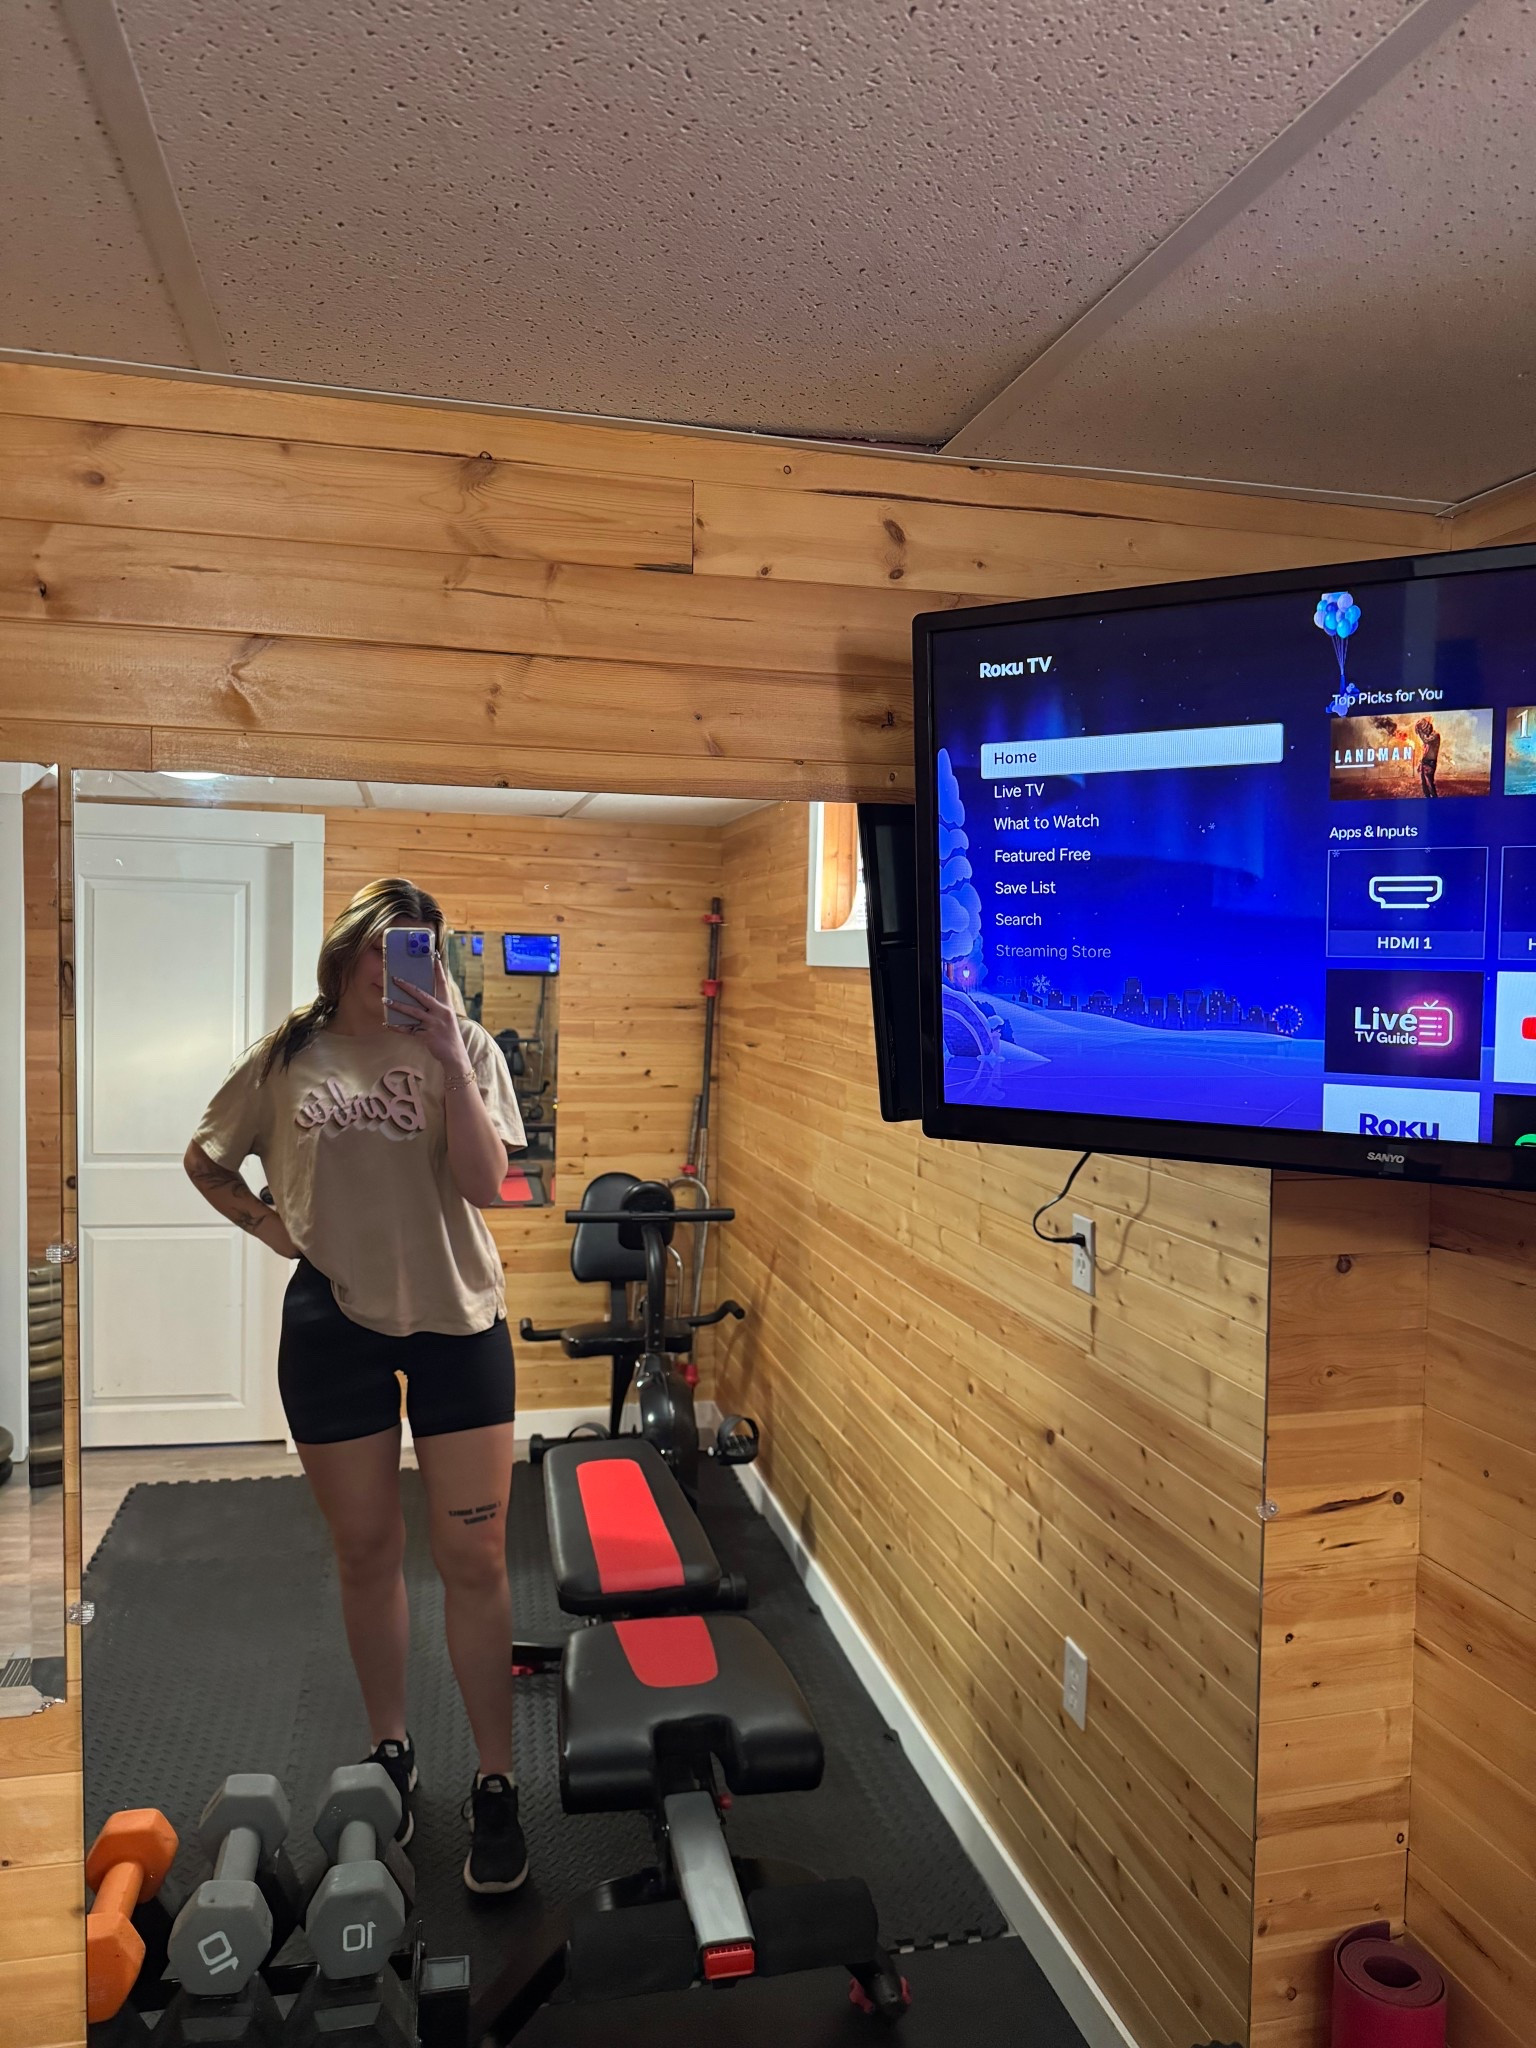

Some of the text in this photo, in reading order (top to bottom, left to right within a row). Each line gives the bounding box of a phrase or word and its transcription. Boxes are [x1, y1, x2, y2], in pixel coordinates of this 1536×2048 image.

[1027, 655, 1053, 674] TV
[1332, 688, 1444, 707] Top Picks for You
[993, 752, 1037, 765] Home
[1334, 747, 1412, 764] LANDMAN
[994, 783, 1045, 799] Live TV
[993, 813, 1100, 831] What to Watch
[1329, 824, 1419, 840] Apps & Inputs
[994, 847, 1092, 863] Featured Free
[995, 880, 1057, 895] Save List
[995, 912, 1043, 926] Search
[1377, 936, 1433, 950] HDMI 1
[995, 944, 1112, 961] Streaming Store
[1354, 1006, 1418, 1031] Live
[1354, 1030, 1418, 1045] TV Guide
[1366, 1151, 1405, 1164] SANYO
